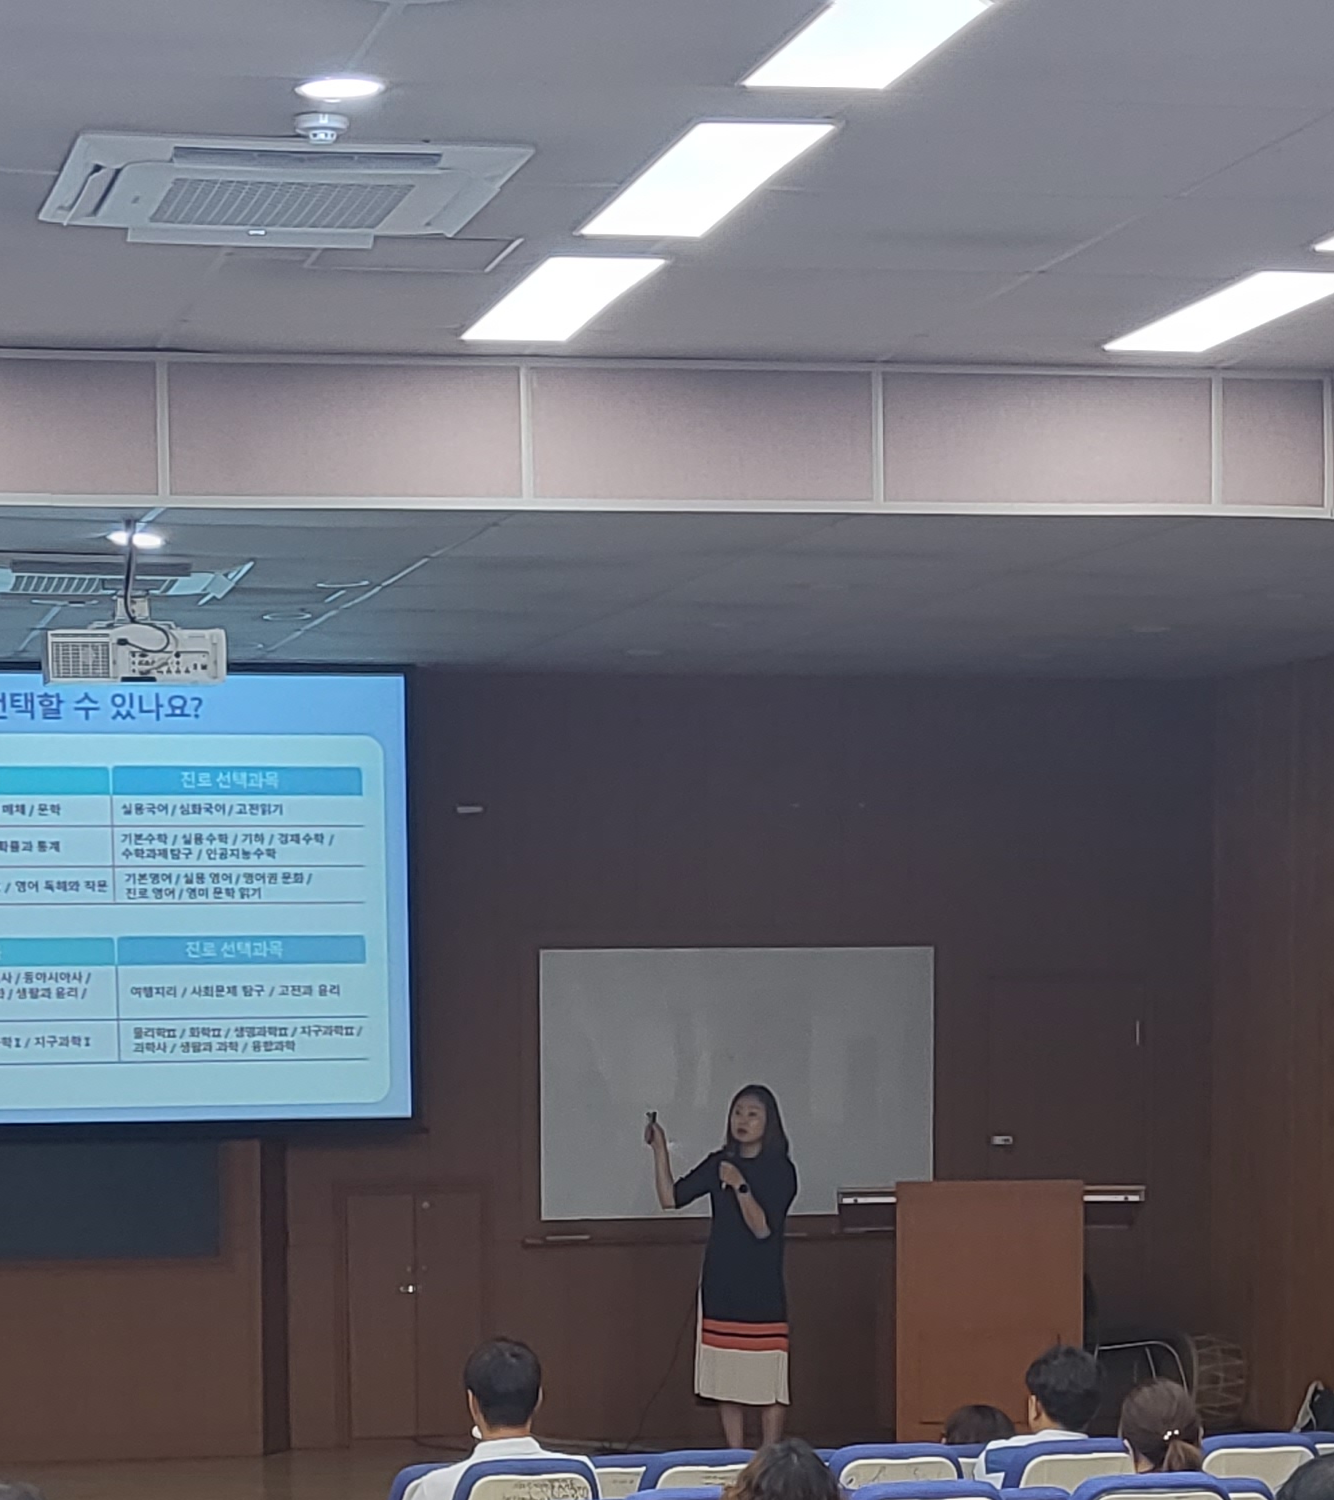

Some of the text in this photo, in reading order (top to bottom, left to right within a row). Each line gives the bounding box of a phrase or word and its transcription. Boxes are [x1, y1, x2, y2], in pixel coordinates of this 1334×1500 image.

[72, 692, 101, 721] 수
[108, 692, 204, 721] 있나요?
[180, 770, 281, 789] 진로 선택과목
[185, 940, 283, 960] 진로 선택과목
